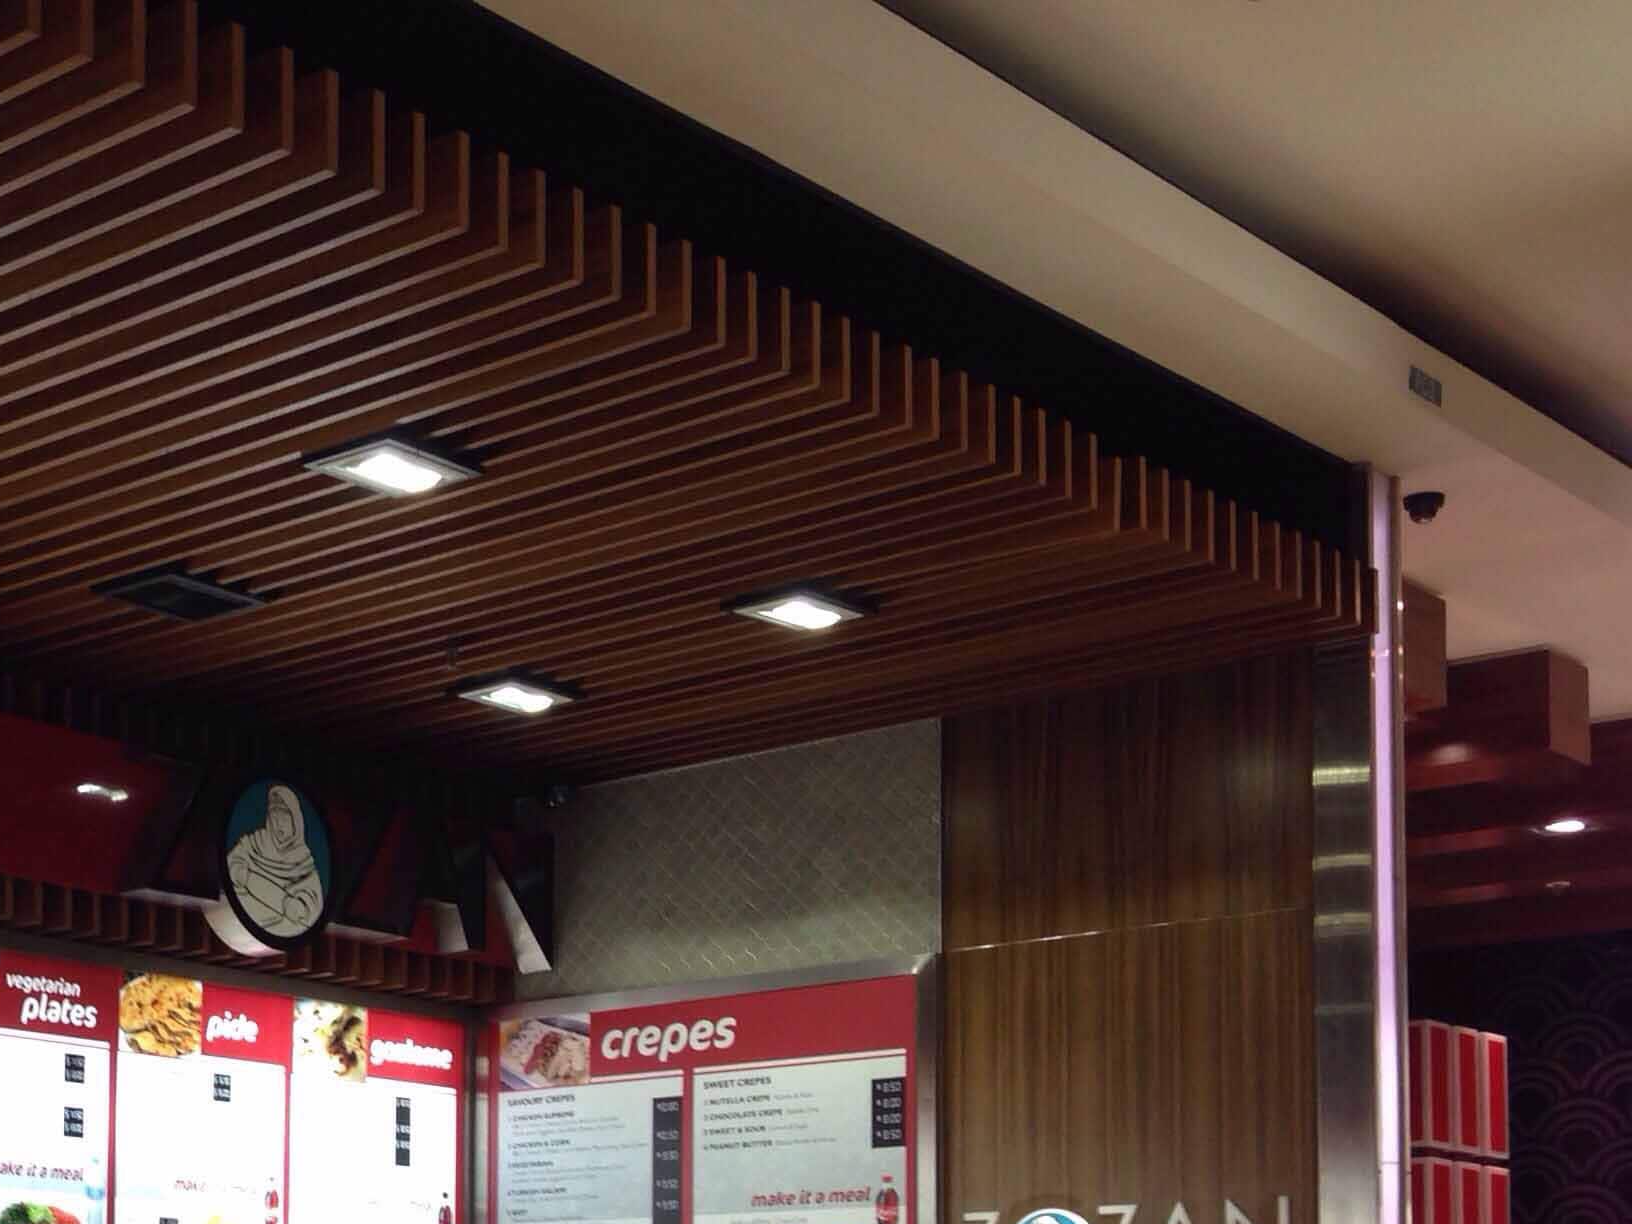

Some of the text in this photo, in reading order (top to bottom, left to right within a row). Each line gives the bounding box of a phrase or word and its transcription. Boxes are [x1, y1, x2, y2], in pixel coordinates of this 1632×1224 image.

[6, 973, 81, 997] vegetarian
[21, 993, 98, 1028] plates
[601, 1016, 737, 1062] crepes
[703, 1076, 771, 1090] SWEET CREPES
[751, 1186, 872, 1208] make it a meal
